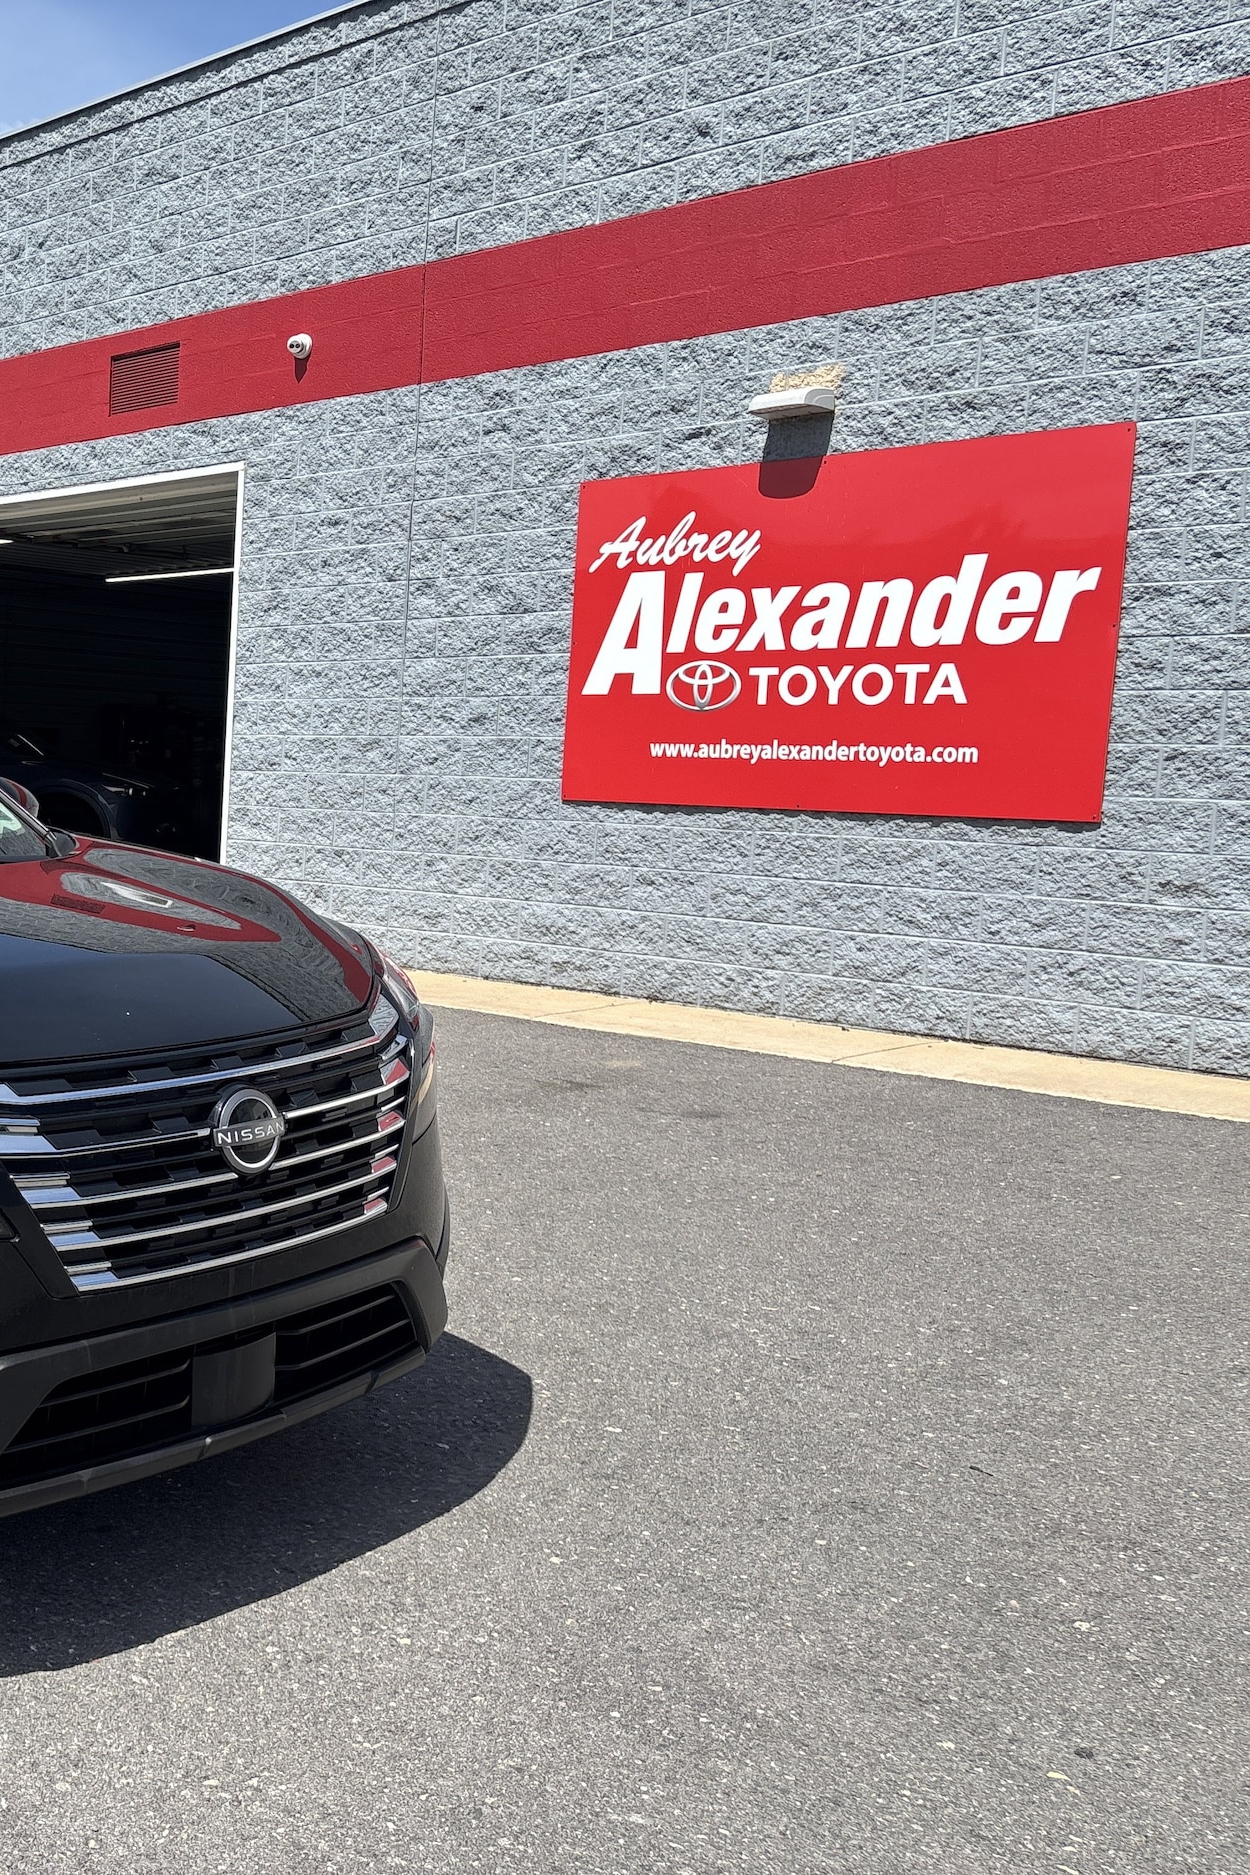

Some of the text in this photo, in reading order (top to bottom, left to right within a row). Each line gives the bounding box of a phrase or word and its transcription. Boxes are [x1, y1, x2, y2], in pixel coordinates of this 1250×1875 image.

[589, 511, 761, 576] Aubrey
[581, 553, 1102, 696] Alexander
[749, 663, 968, 705] TOYOTA
[649, 739, 979, 765] www.aubreyalexandertoyota.com
[217, 1122, 284, 1144] NISSAN
